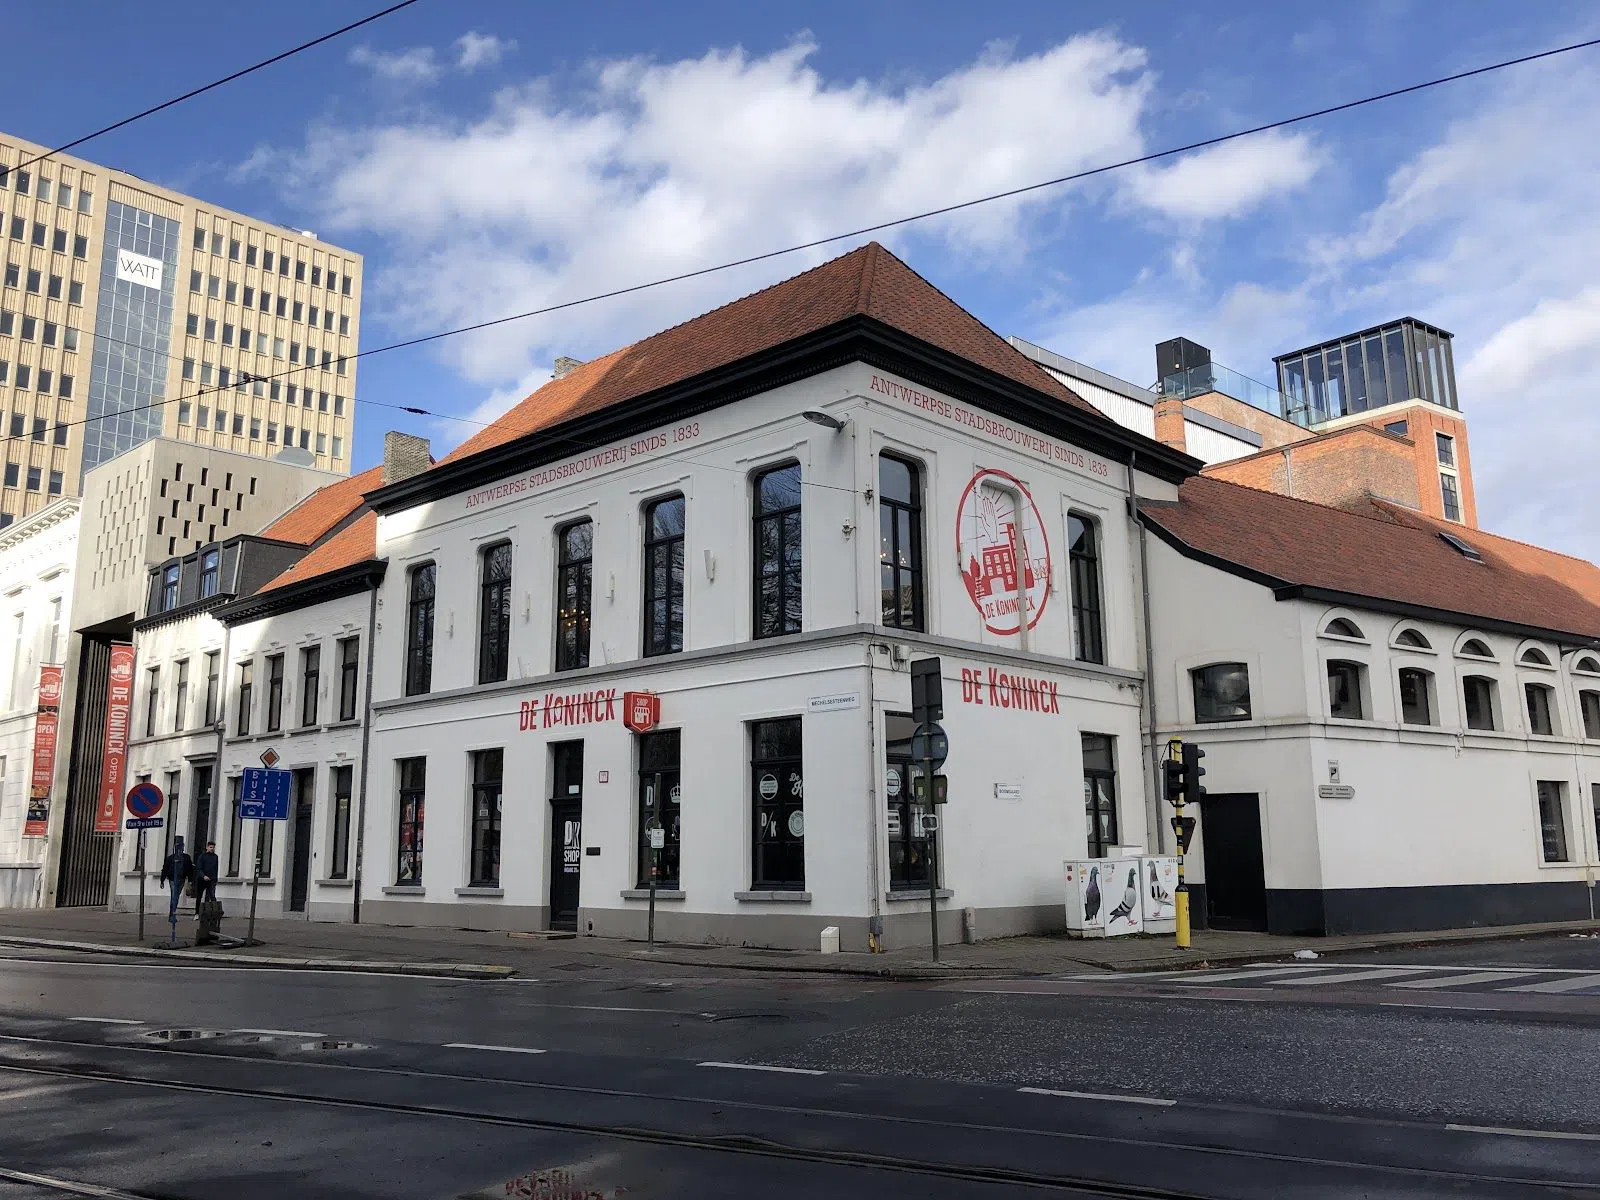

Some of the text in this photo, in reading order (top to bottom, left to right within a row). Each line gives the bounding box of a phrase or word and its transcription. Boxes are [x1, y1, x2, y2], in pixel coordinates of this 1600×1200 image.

[121, 257, 159, 279] WATT
[870, 375, 1108, 477] ANTWERPSE STADSBROUWERIJ SINDS 1833
[466, 422, 700, 508] ANTWERPSE STADSBROUWERIJ SINDS 1833
[985, 602, 995, 618] DE
[112, 686, 129, 701] DE
[636, 697, 649, 706] SHOP
[962, 666, 1059, 714] DE KONINCK
[519, 687, 616, 731] DE KONINCK
[37, 724, 54, 734] OPEN
[108, 704, 129, 755] KONINCK
[108, 757, 119, 784] OPEN
[564, 850, 580, 863] SHOP
